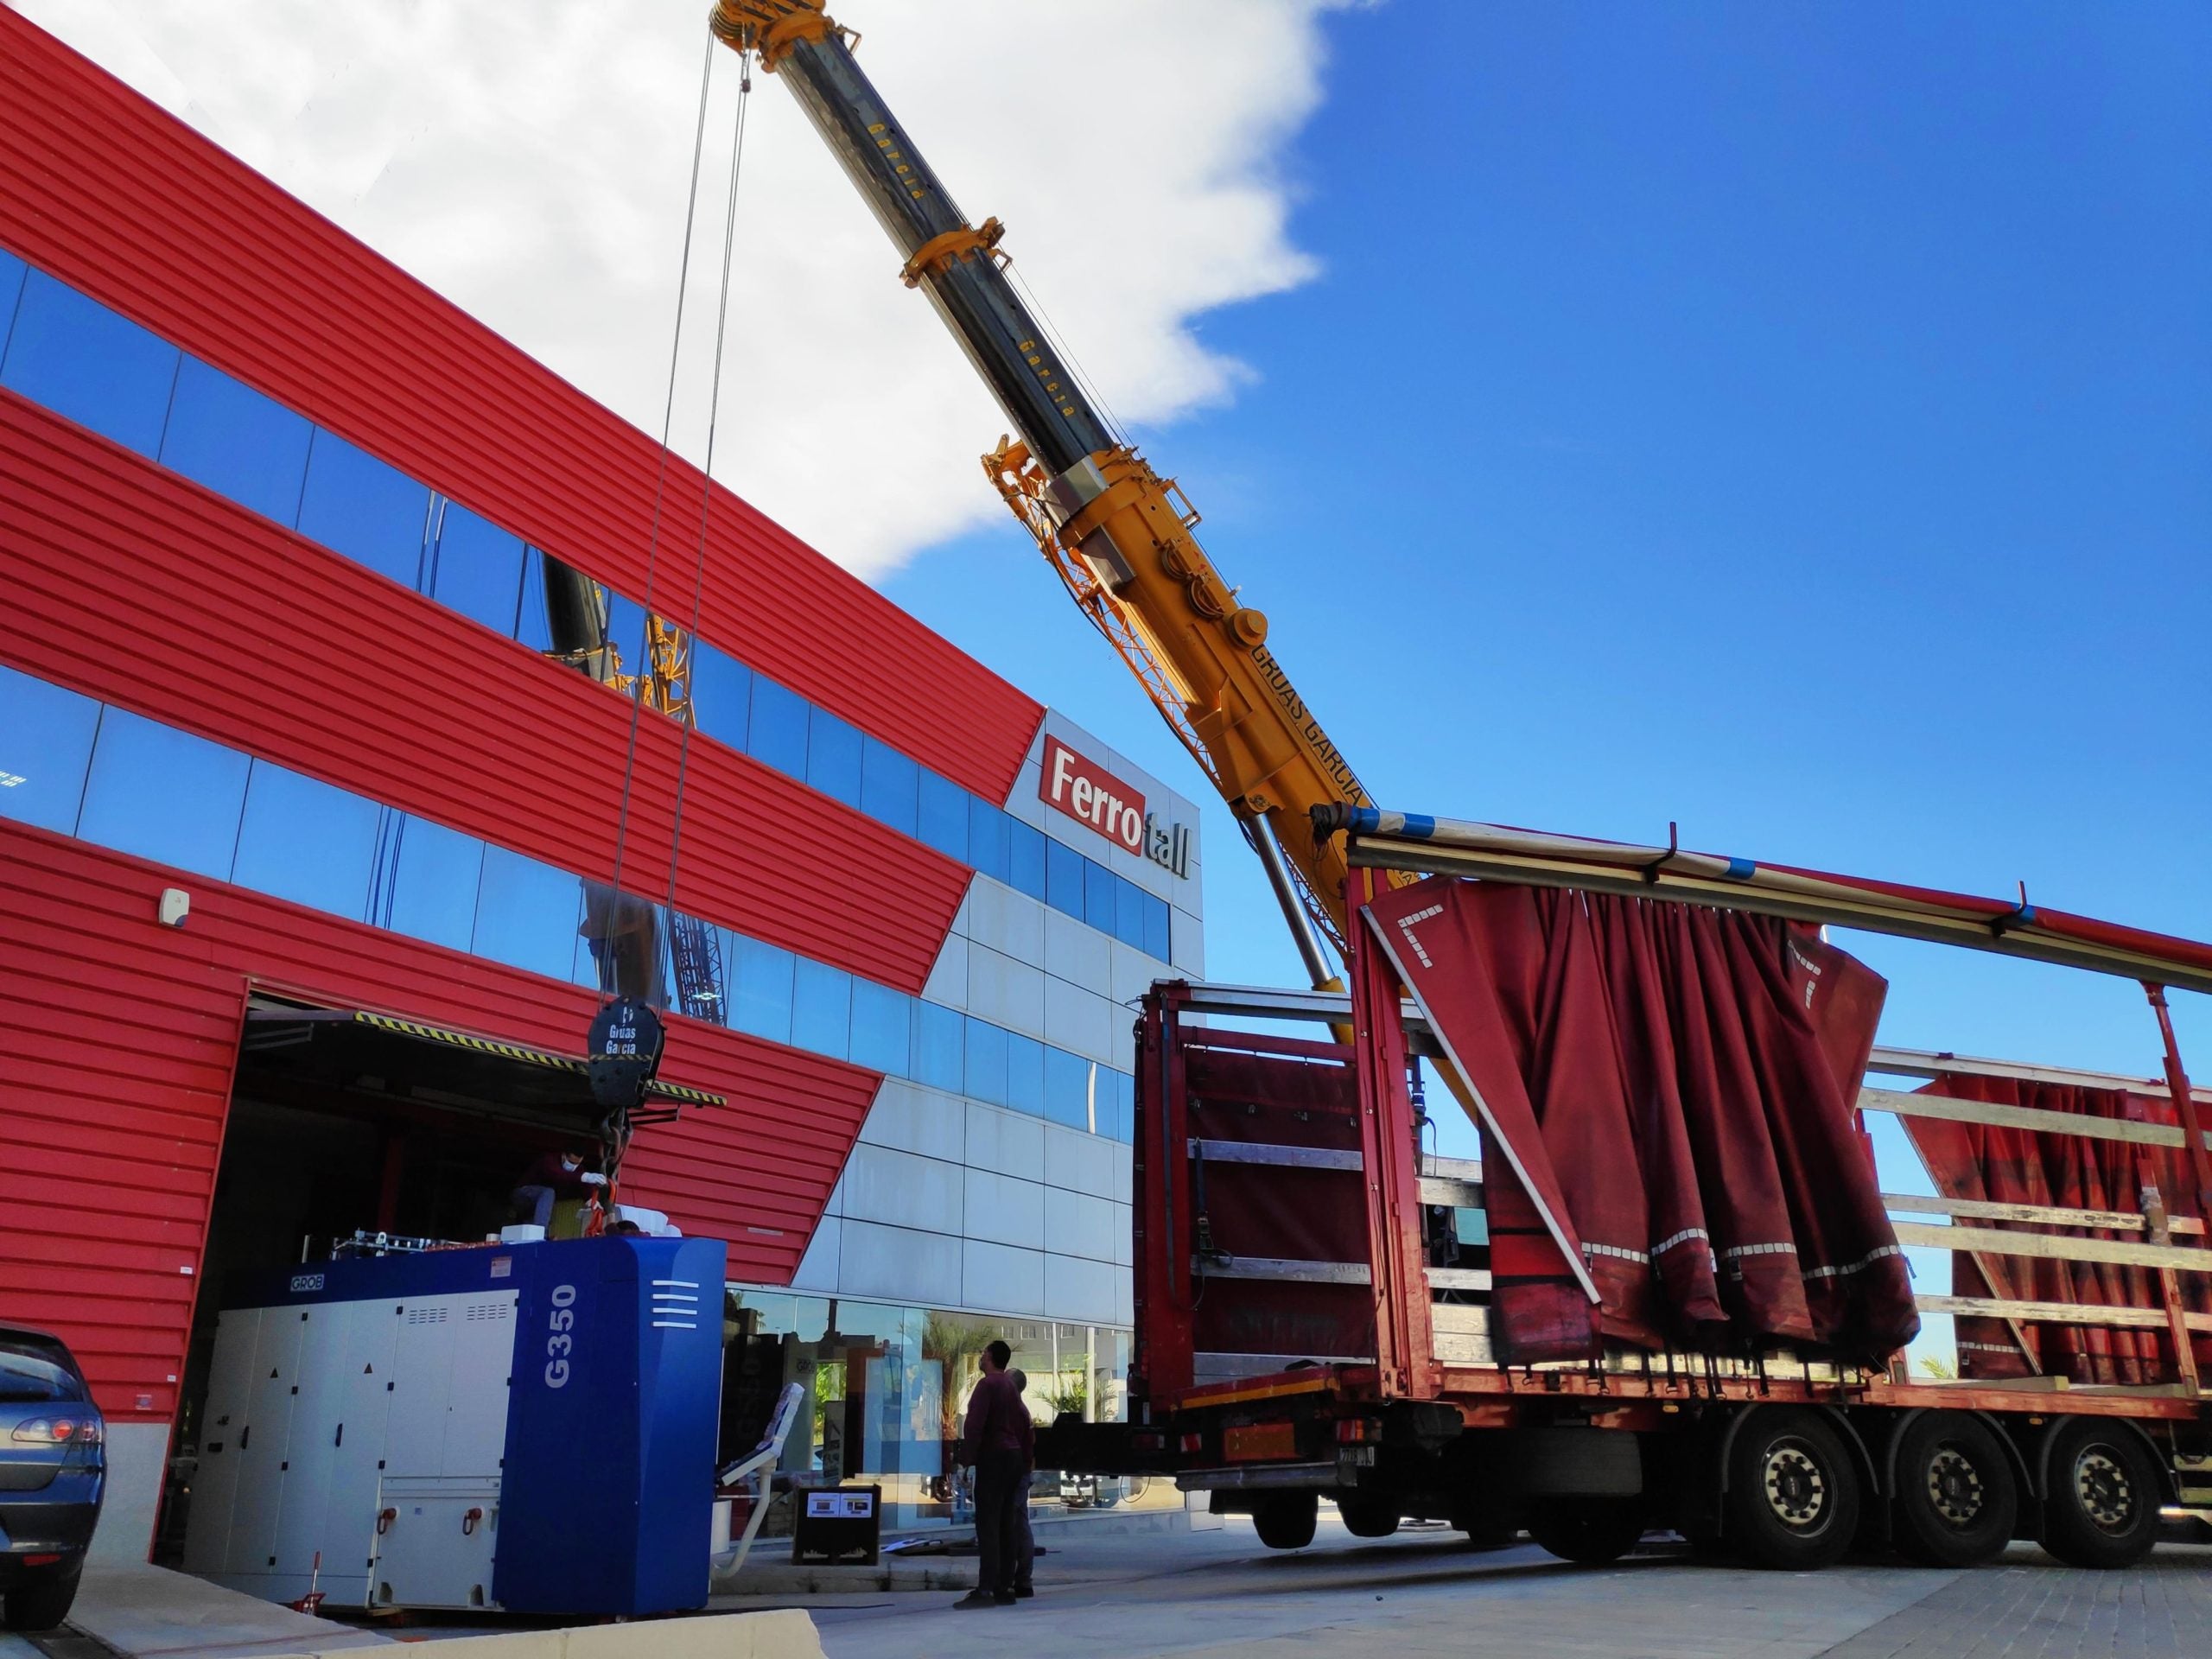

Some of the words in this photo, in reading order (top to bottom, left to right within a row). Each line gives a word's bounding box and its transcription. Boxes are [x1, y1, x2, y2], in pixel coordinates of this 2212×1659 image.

[1019, 340, 1075, 416] Garcia
[1251, 644, 1309, 721] GRUAS
[1304, 720, 1363, 806] GARCIA
[292, 1275, 323, 1290] GROB
[545, 1285, 576, 1389] G350
